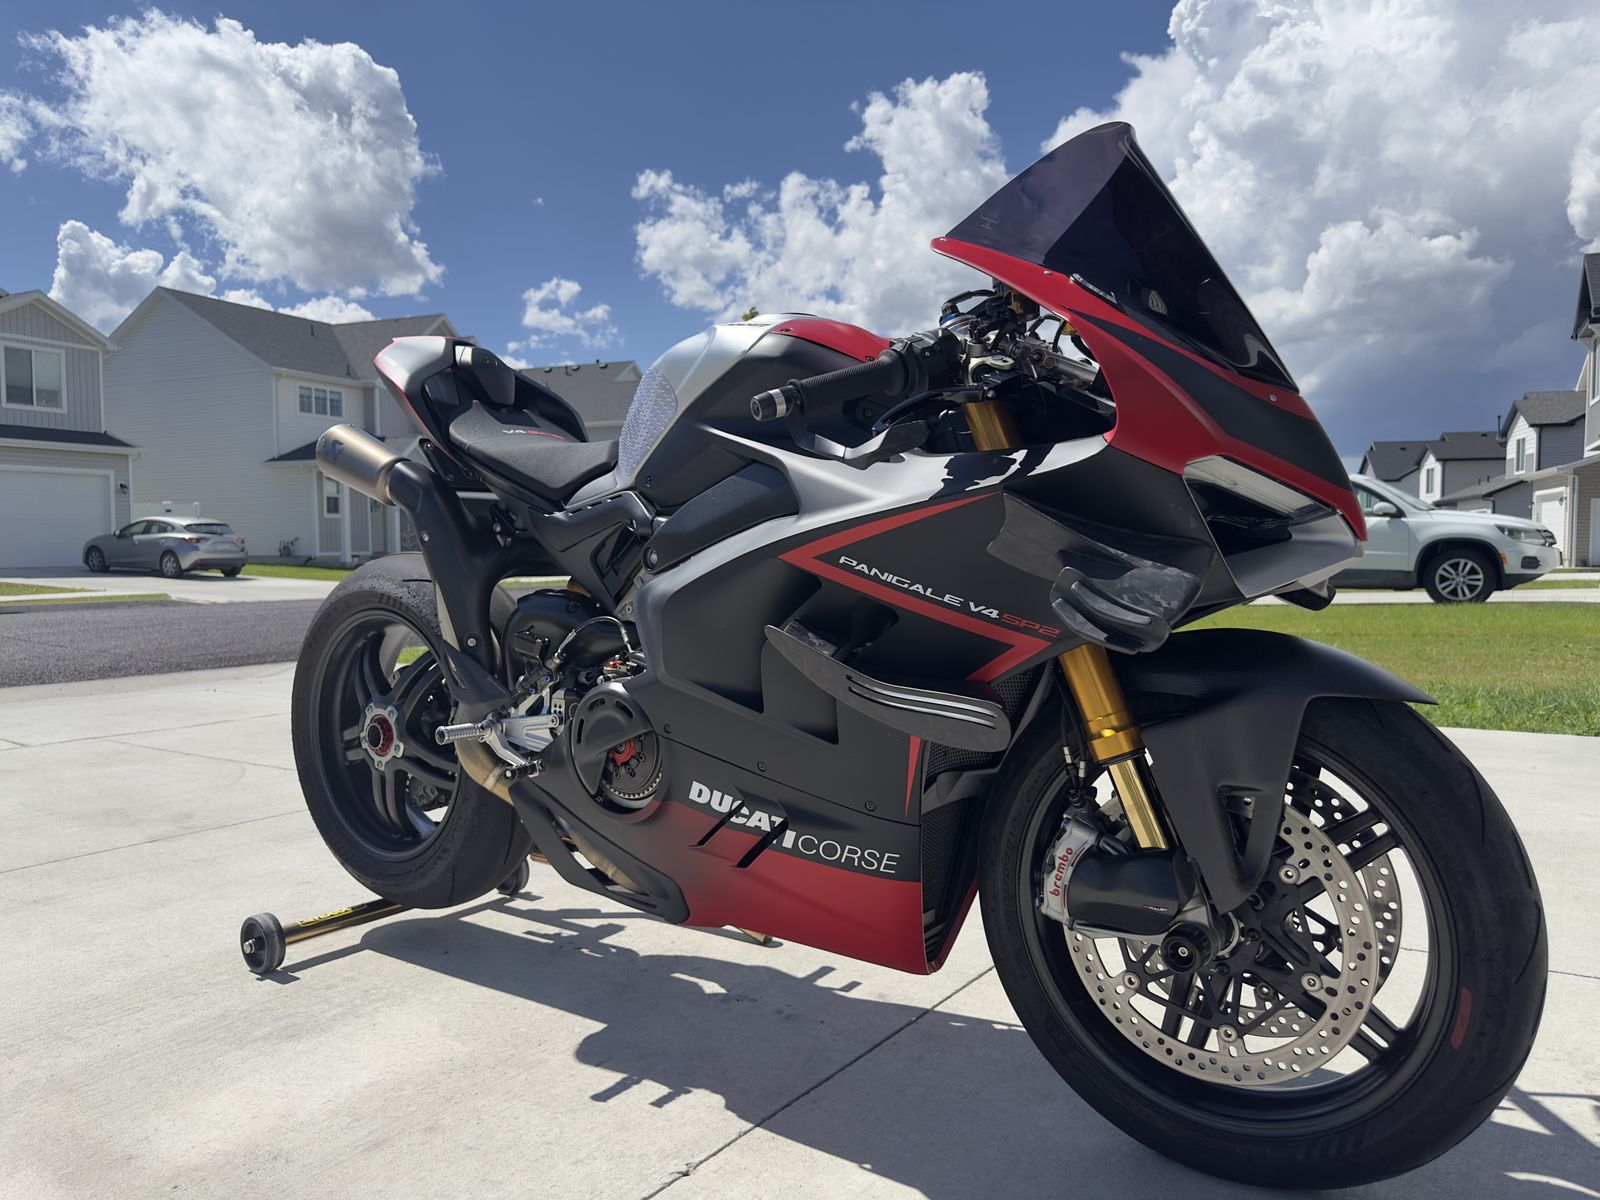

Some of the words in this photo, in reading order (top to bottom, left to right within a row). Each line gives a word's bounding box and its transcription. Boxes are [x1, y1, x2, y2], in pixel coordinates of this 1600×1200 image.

[838, 555, 964, 607] PANIGALE
[969, 601, 1000, 619] V4
[798, 835, 900, 874] CORSE
[1050, 847, 1074, 897] brembo
